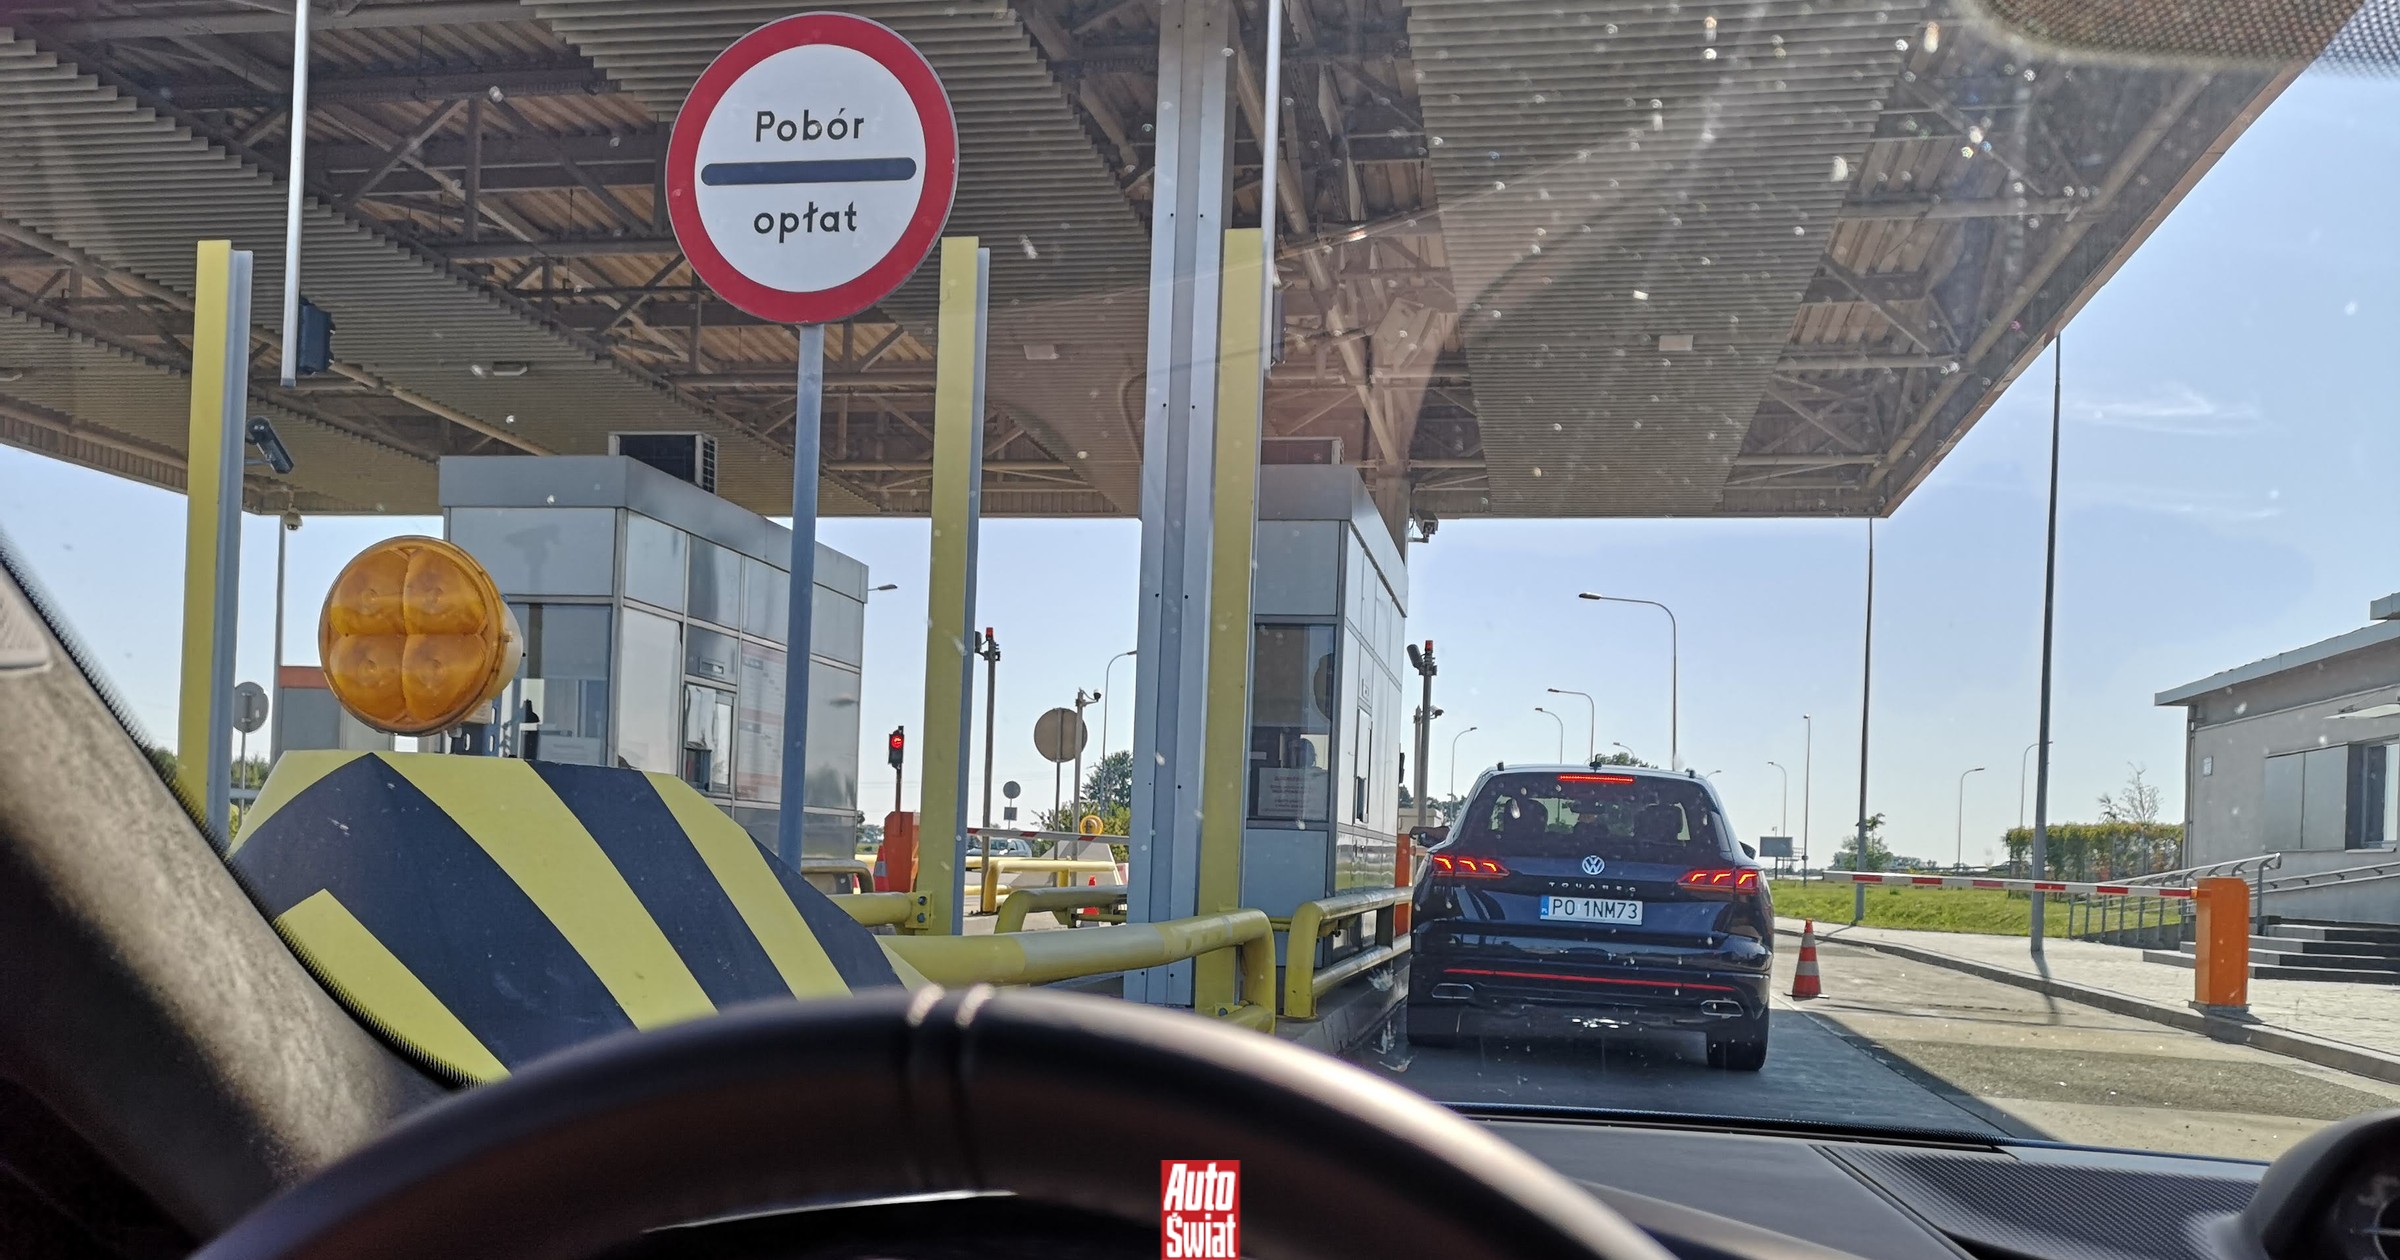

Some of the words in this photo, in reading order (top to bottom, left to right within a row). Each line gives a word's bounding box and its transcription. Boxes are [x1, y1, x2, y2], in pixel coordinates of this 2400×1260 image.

[755, 107, 864, 142] Pobór
[753, 201, 857, 243] opłat
[1548, 881, 1636, 892] TOUAREG
[1552, 898, 1575, 916] PO
[1583, 900, 1638, 919] 1NM73
